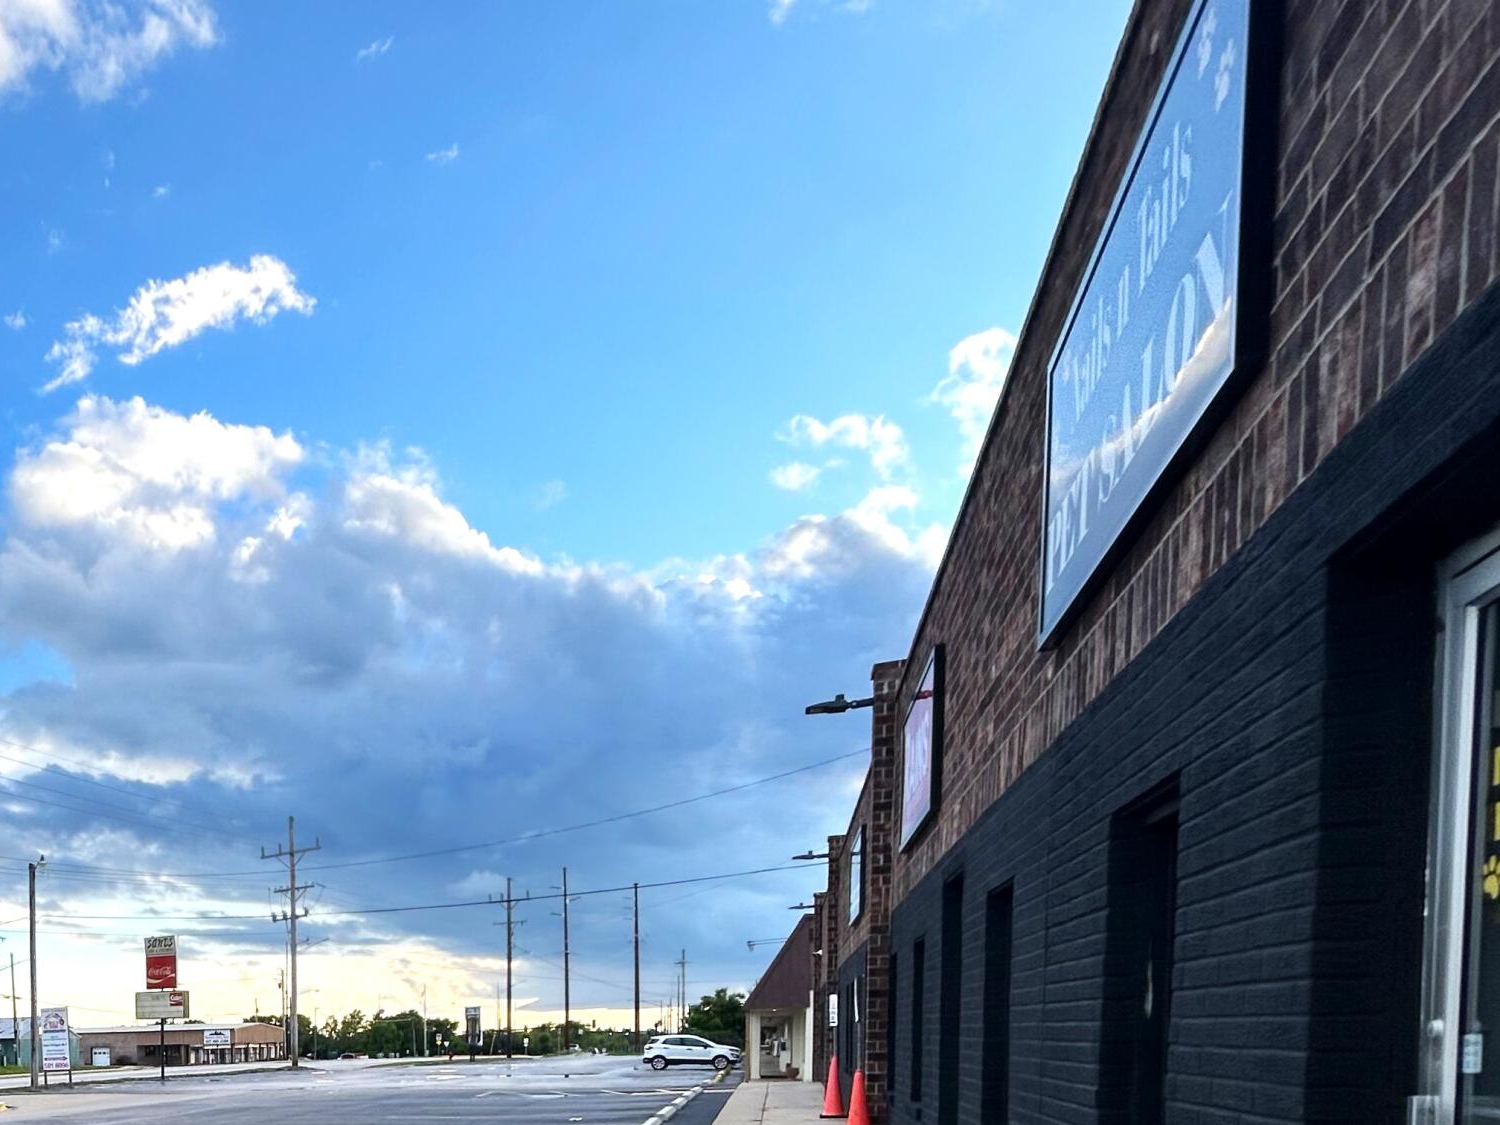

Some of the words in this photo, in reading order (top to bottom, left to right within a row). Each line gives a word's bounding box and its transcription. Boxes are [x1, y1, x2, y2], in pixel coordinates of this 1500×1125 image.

[1134, 119, 1192, 299] Tails
[1047, 444, 1097, 598] PET
[1098, 187, 1233, 504] SALON
